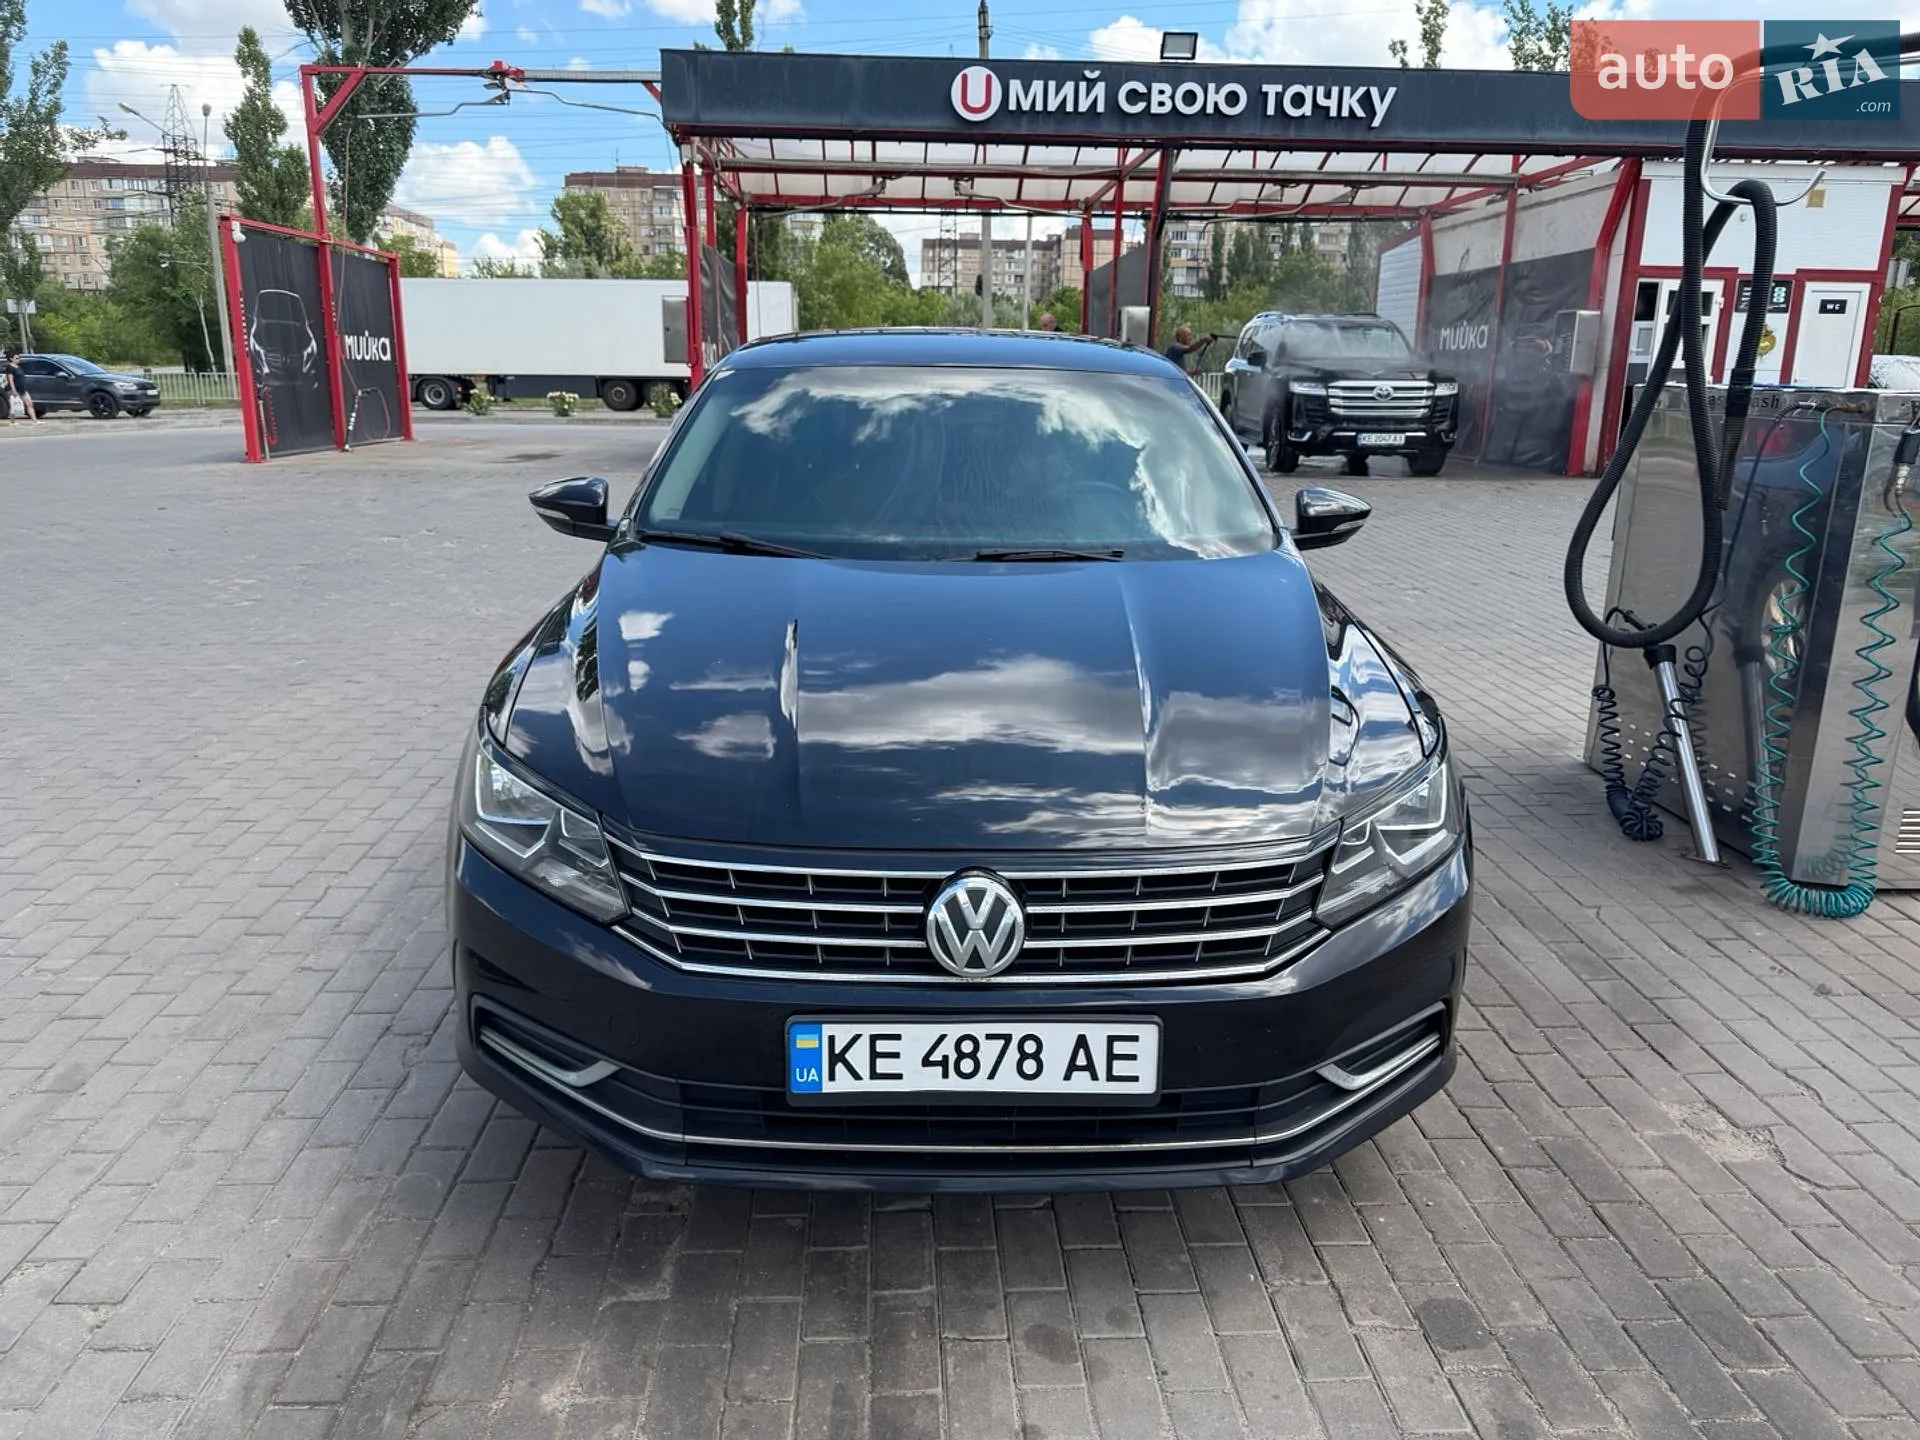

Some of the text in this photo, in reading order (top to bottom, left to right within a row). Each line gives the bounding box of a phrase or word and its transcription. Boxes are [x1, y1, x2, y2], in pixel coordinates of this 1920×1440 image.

[827, 1033, 1140, 1083] KE 4878 AE
[795, 1067, 819, 1082] UA
